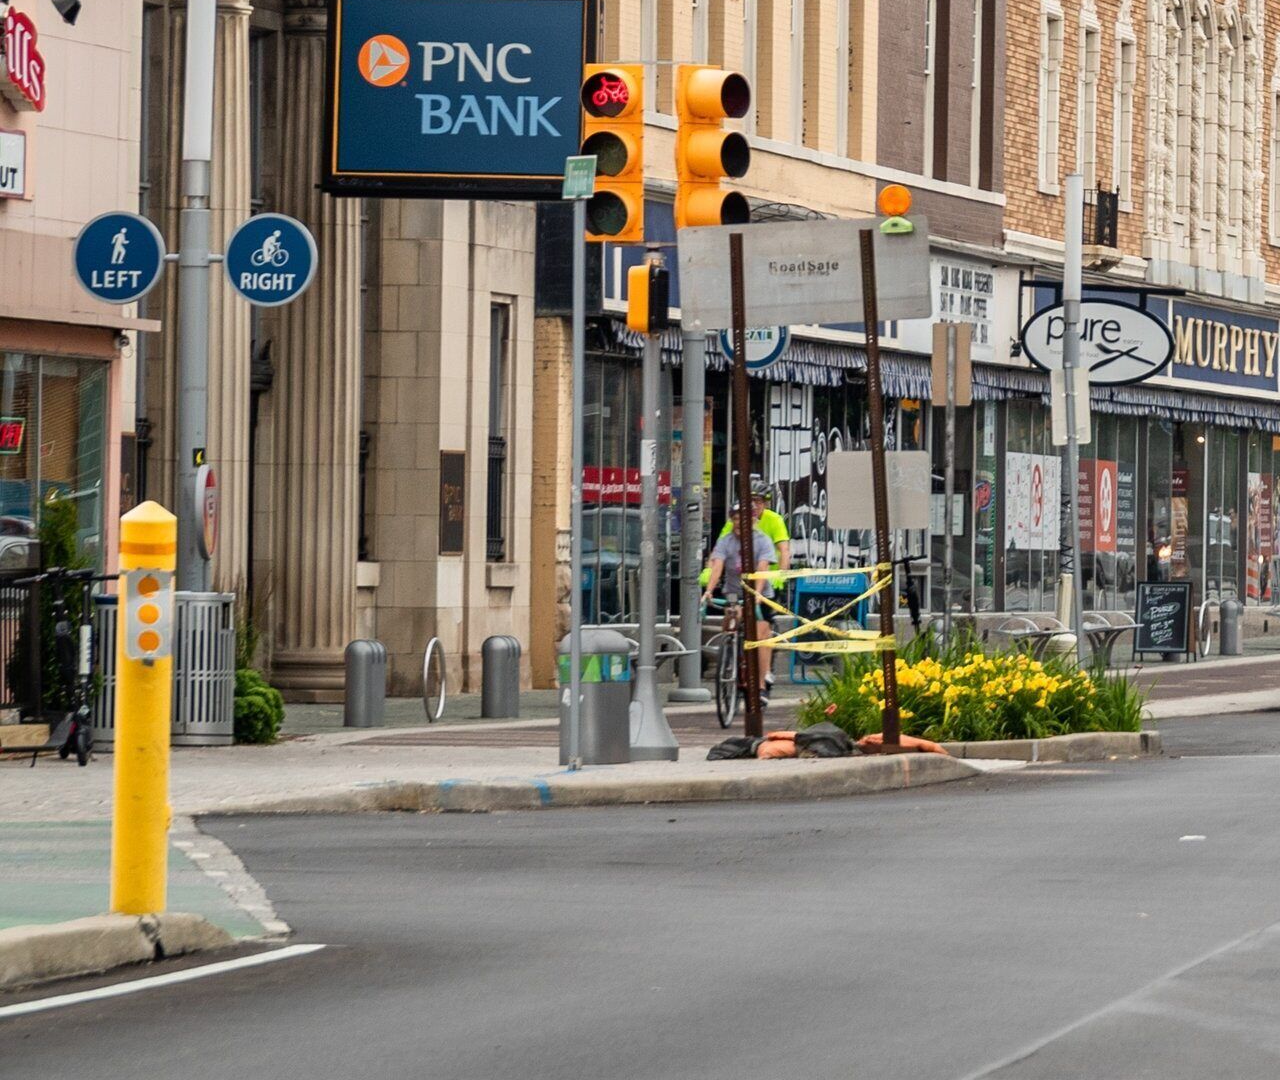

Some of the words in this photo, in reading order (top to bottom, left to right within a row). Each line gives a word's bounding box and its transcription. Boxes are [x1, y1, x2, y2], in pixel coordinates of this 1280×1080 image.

[417, 41, 532, 83] PNC
[414, 93, 562, 137] BANK
[91, 270, 143, 289] LEFT
[240, 272, 296, 291] RIGHT
[1174, 315, 1280, 378] MURPHY
[805, 576, 826, 584] BUD
[827, 576, 856, 584] LIGHT
